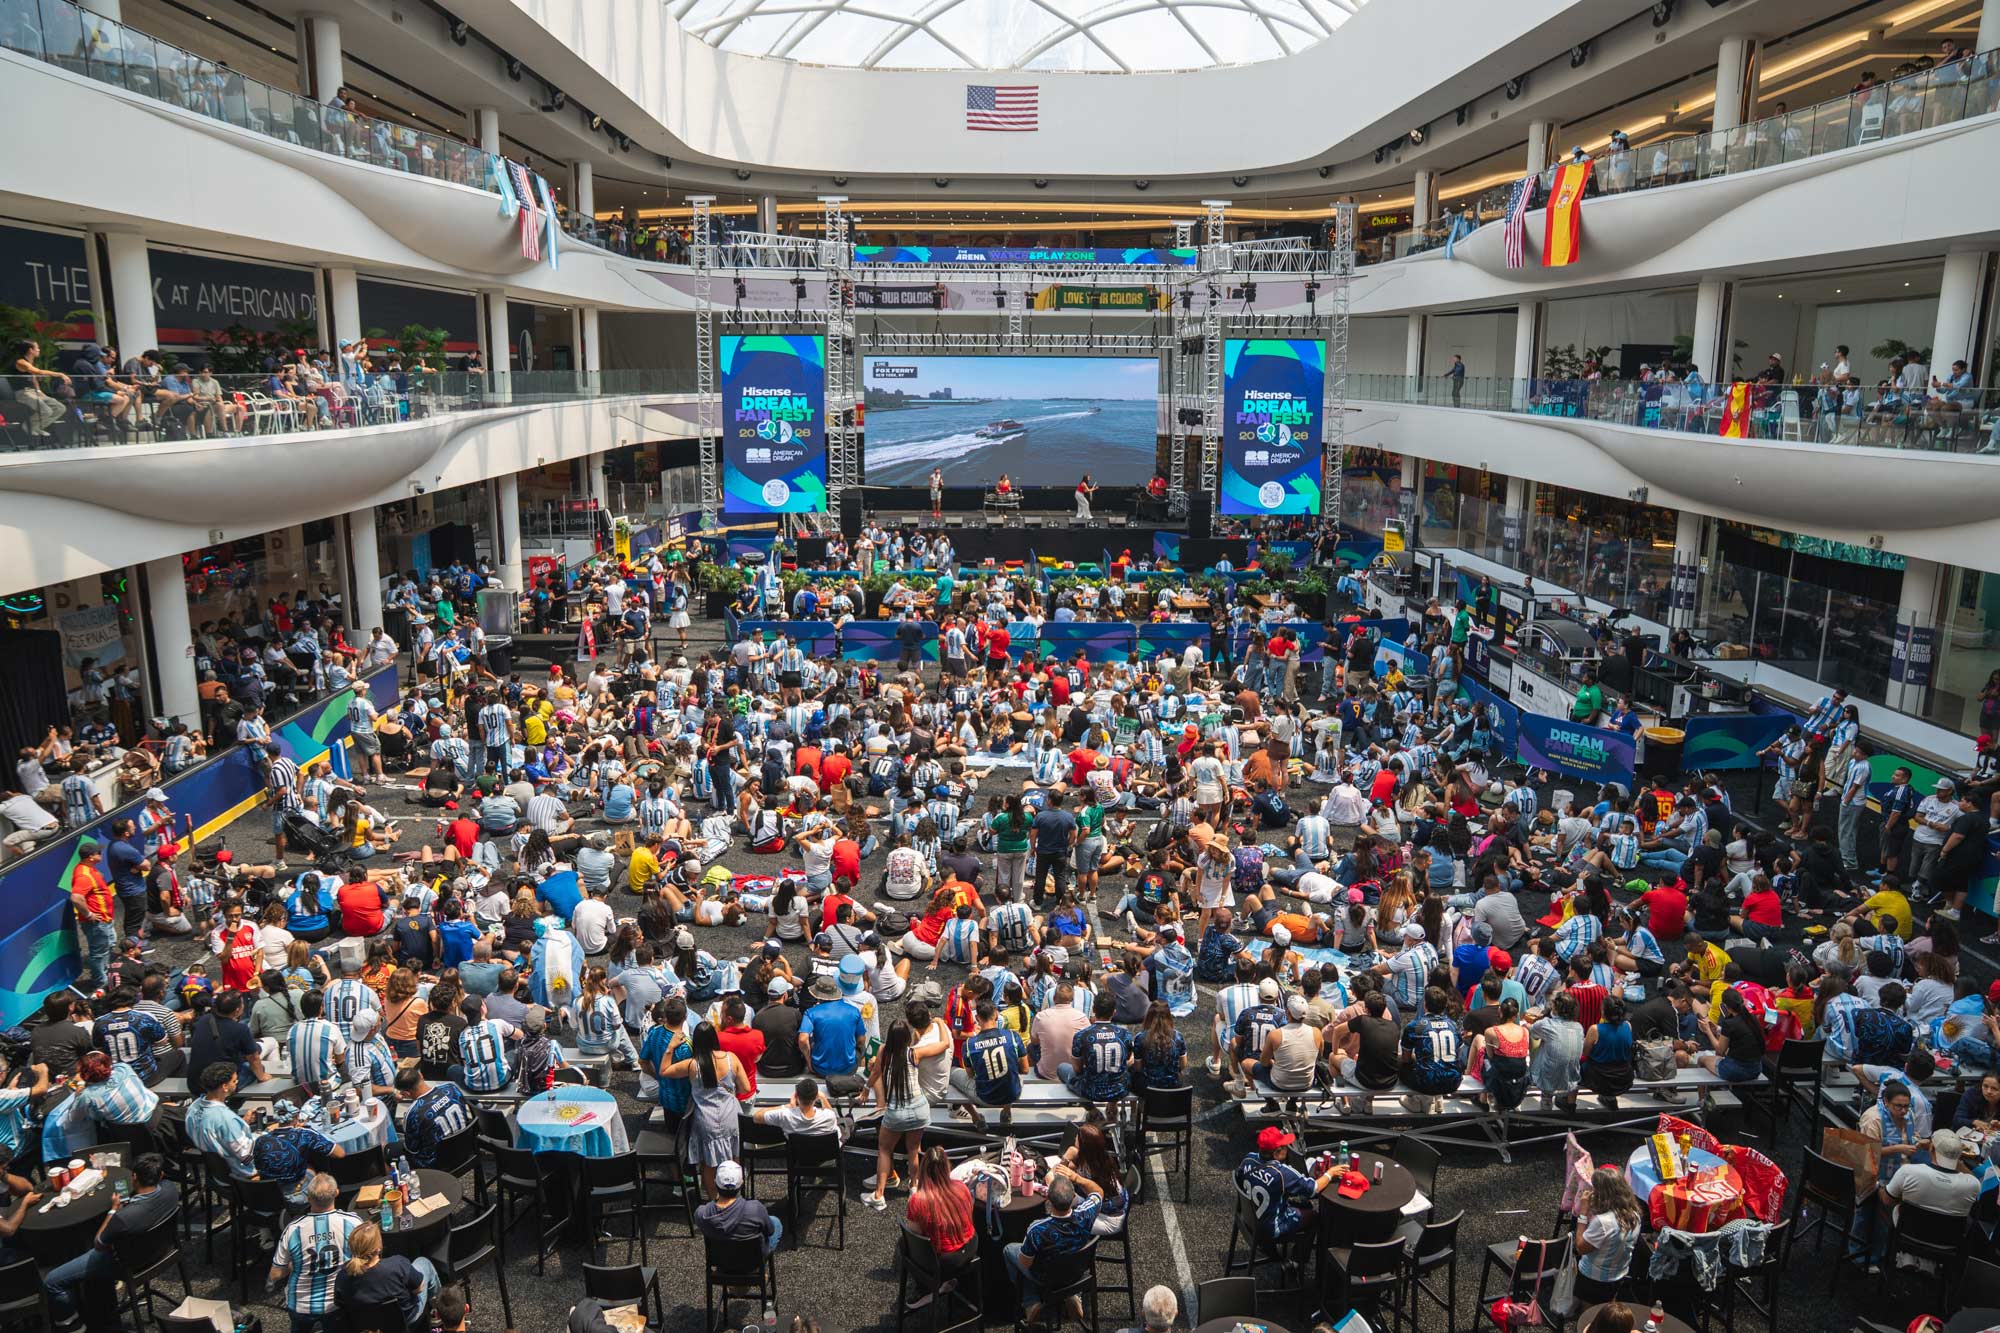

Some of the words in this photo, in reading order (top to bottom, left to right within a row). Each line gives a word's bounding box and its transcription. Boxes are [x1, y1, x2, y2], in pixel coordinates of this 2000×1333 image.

[25, 262, 90, 304] THE
[171, 284, 190, 305] AT
[196, 282, 296, 320] AMERICAN
[900, 292, 934, 304] COLORS
[1064, 292, 1084, 304] LOVE
[1086, 292, 1108, 304] YUR
[1110, 292, 1143, 304] COLORS
[742, 386, 792, 396] Hisense
[1244, 390, 1292, 399] Hisense
[742, 396, 808, 410] DREAM
[1244, 400, 1306, 413] DREAM
[739, 428, 756, 438] 20
[1239, 432, 1255, 440] 20
[1898, 650, 1930, 664] SUERIOR
[1068, 672, 1080, 686] 10
[954, 691, 968, 704] 10
[1353, 704, 1360, 718] 9
[484, 712, 497, 729] 10
[1550, 728, 1604, 751] DREAM
[1040, 753, 1050, 763] 10
[876, 760, 892, 776] 10
[693, 769, 703, 784] 10
[1268, 794, 1282, 812] 10
[1520, 798, 1532, 813] 10
[648, 809, 663, 826] 10
[934, 813, 950, 831] 10
[1520, 967, 1543, 996] 10
[332, 996, 356, 1022] 10
[579, 1011, 606, 1036] 10
[1431, 1021, 1448, 1029] MESSI
[104, 1032, 138, 1063] 10
[974, 1037, 997, 1049] NEYMAR
[998, 1035, 1007, 1043] JR
[1428, 1030, 1457, 1064] 10
[464, 1034, 495, 1068] 10
[1093, 1042, 1120, 1073] 10
[982, 1045, 1008, 1080] 10
[431, 1096, 450, 1112] MESSI
[434, 1103, 466, 1137] 10
[308, 1232, 335, 1244] MESSI
[304, 1245, 340, 1274] 10
